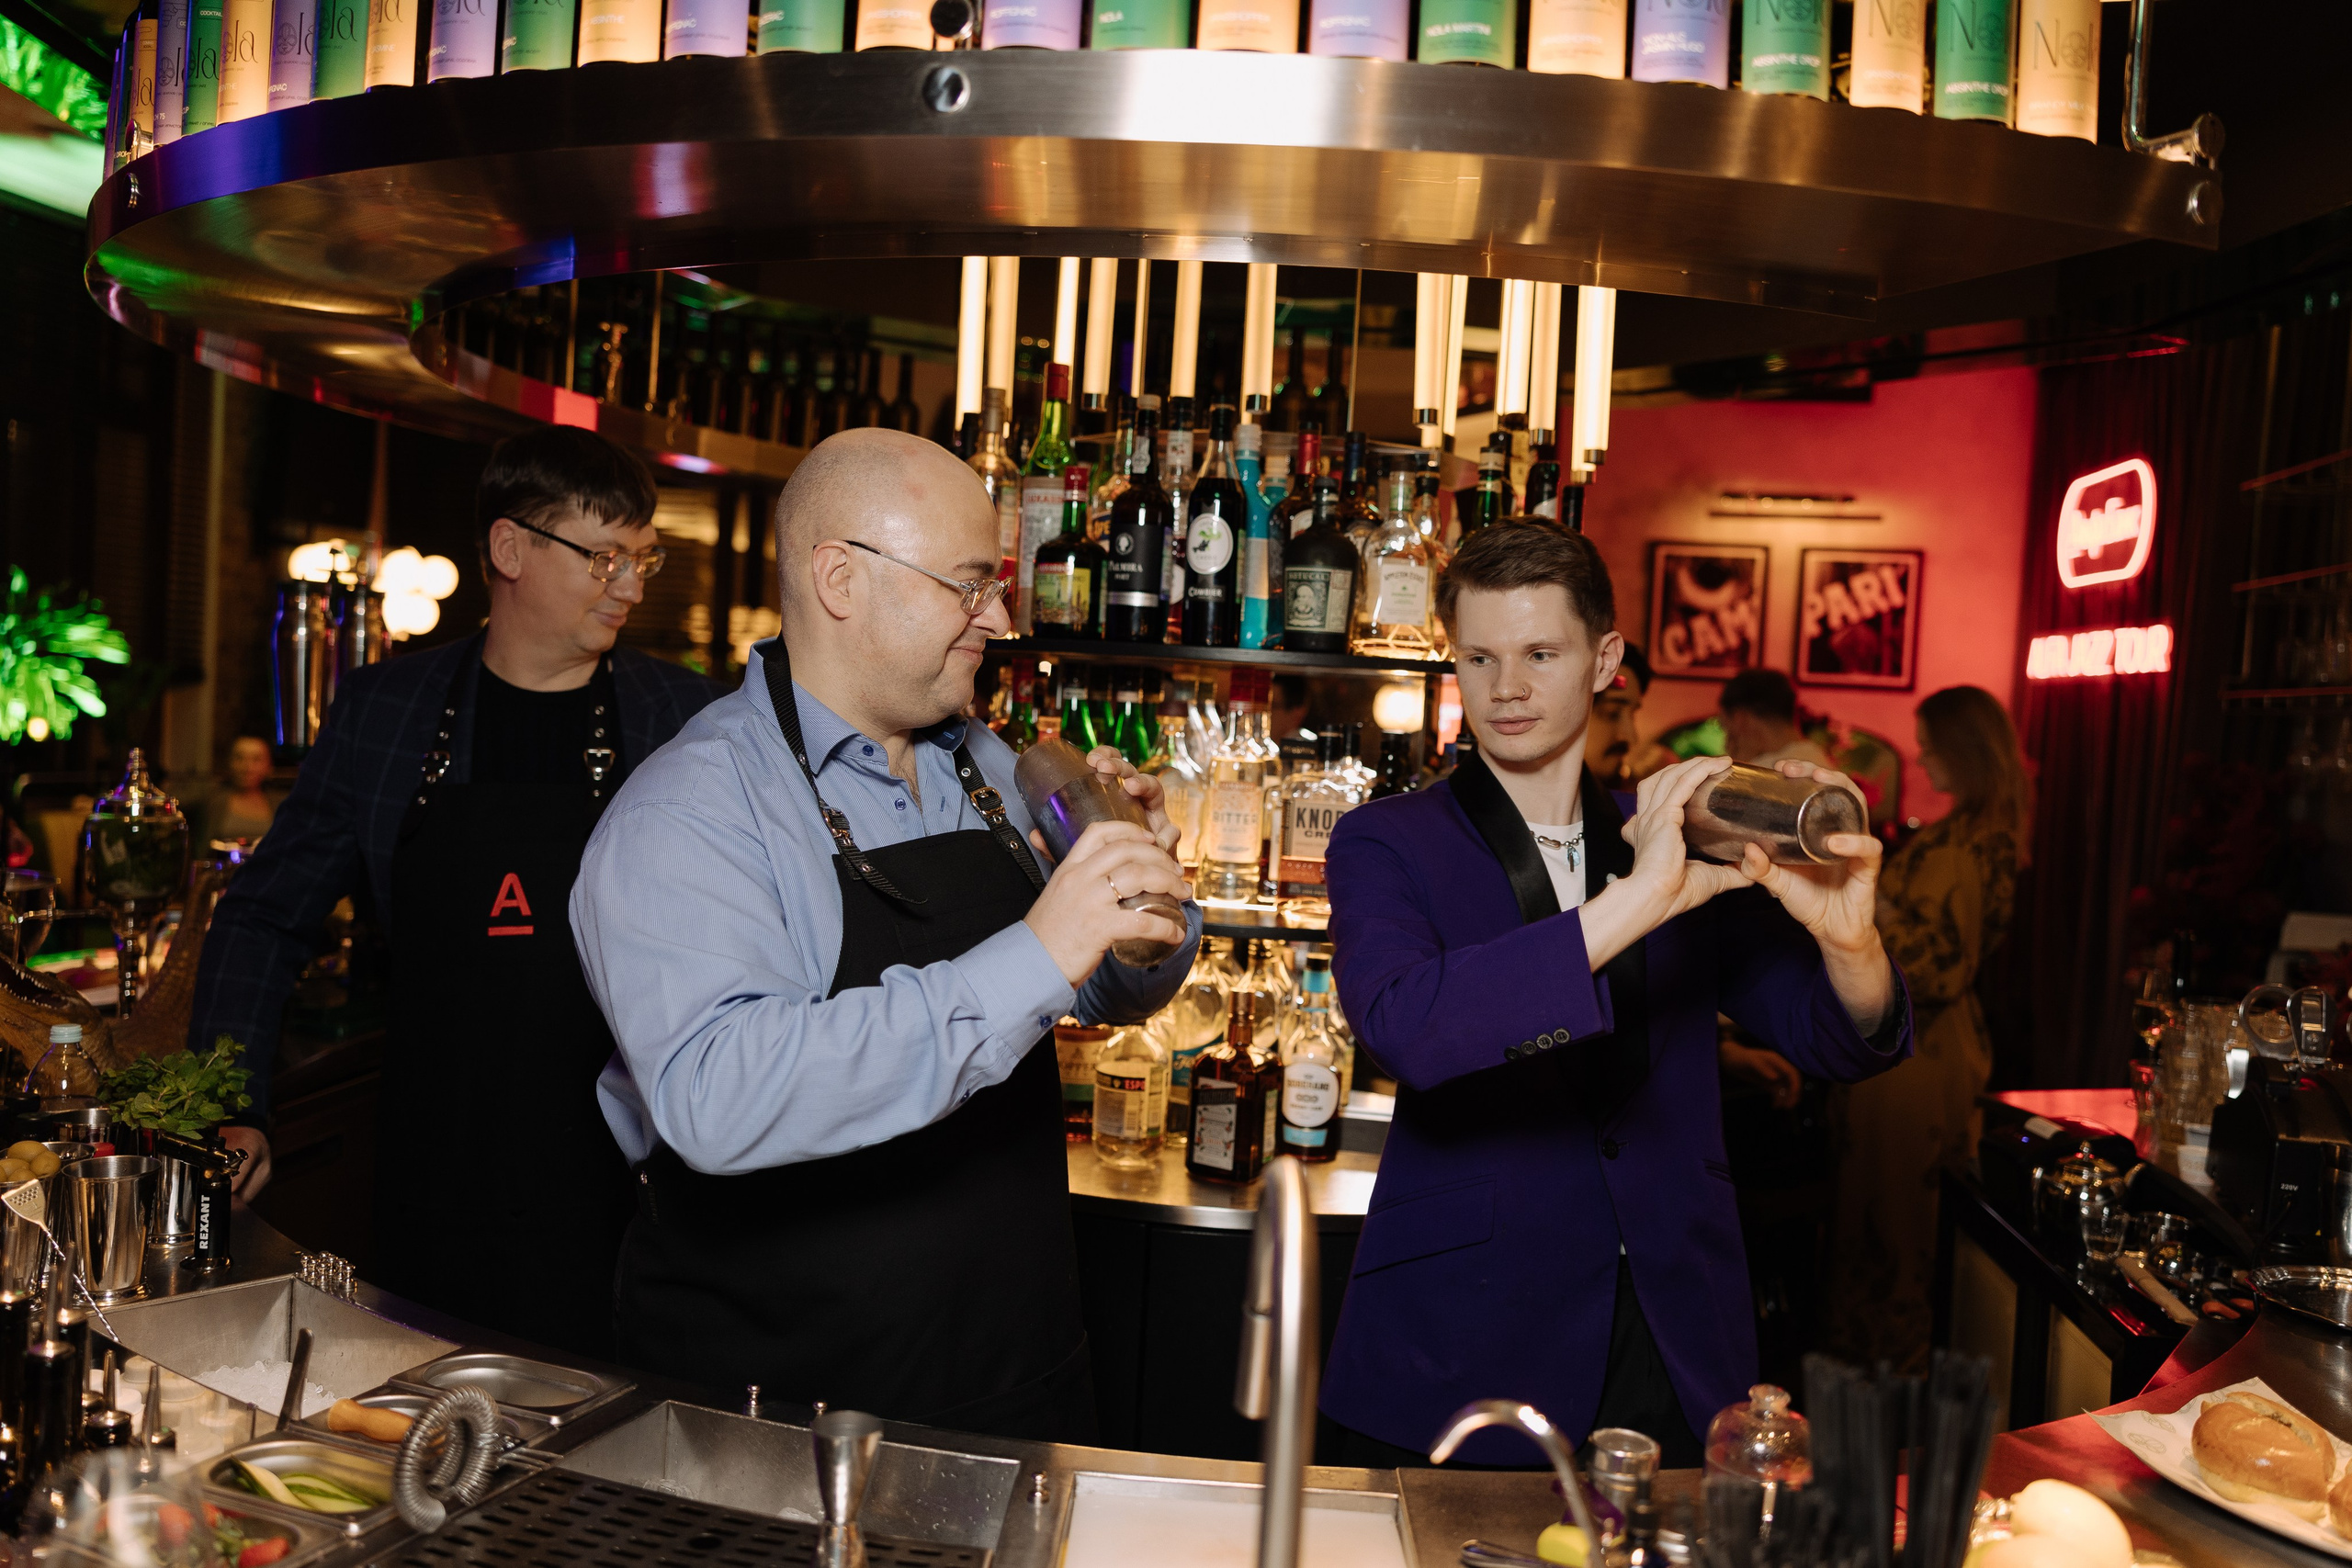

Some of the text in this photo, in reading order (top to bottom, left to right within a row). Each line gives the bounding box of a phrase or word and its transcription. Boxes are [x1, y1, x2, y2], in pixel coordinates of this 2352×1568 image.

[1213, 811, 1258, 825] BITTER
[490, 872, 532, 917] A
[2280, 1182, 2299, 1191] 220V
[198, 1194, 210, 1250] REXANT
